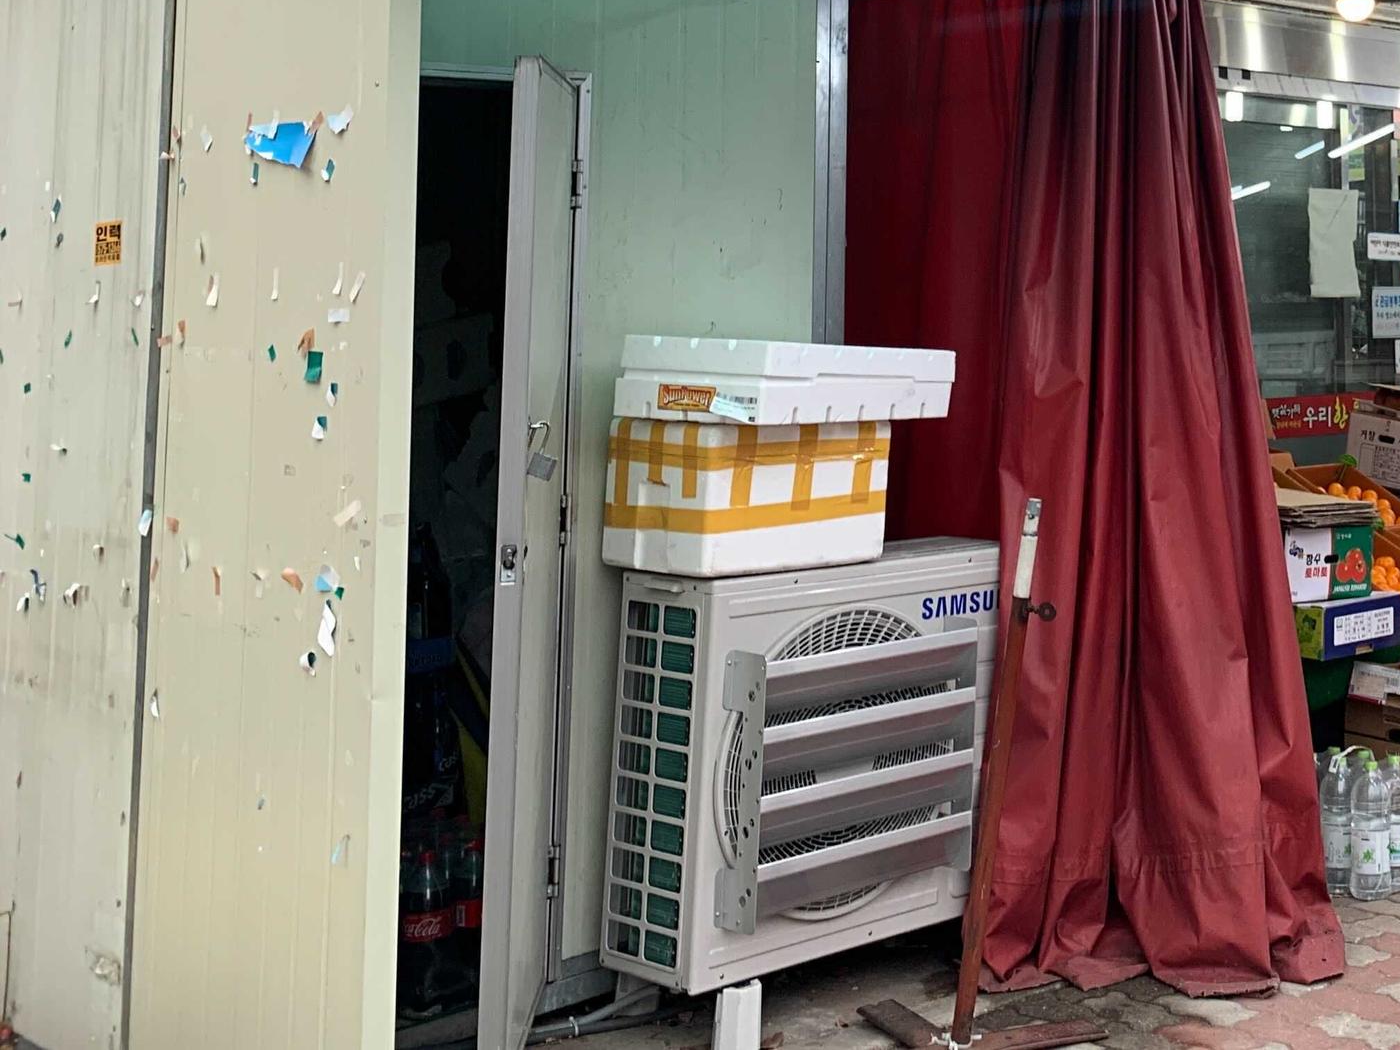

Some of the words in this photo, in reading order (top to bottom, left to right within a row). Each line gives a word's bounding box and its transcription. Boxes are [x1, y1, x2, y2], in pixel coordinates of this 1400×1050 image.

[96, 225, 121, 242] 인력
[1303, 406, 1331, 429] 우리
[922, 588, 1000, 620] SAMSU
